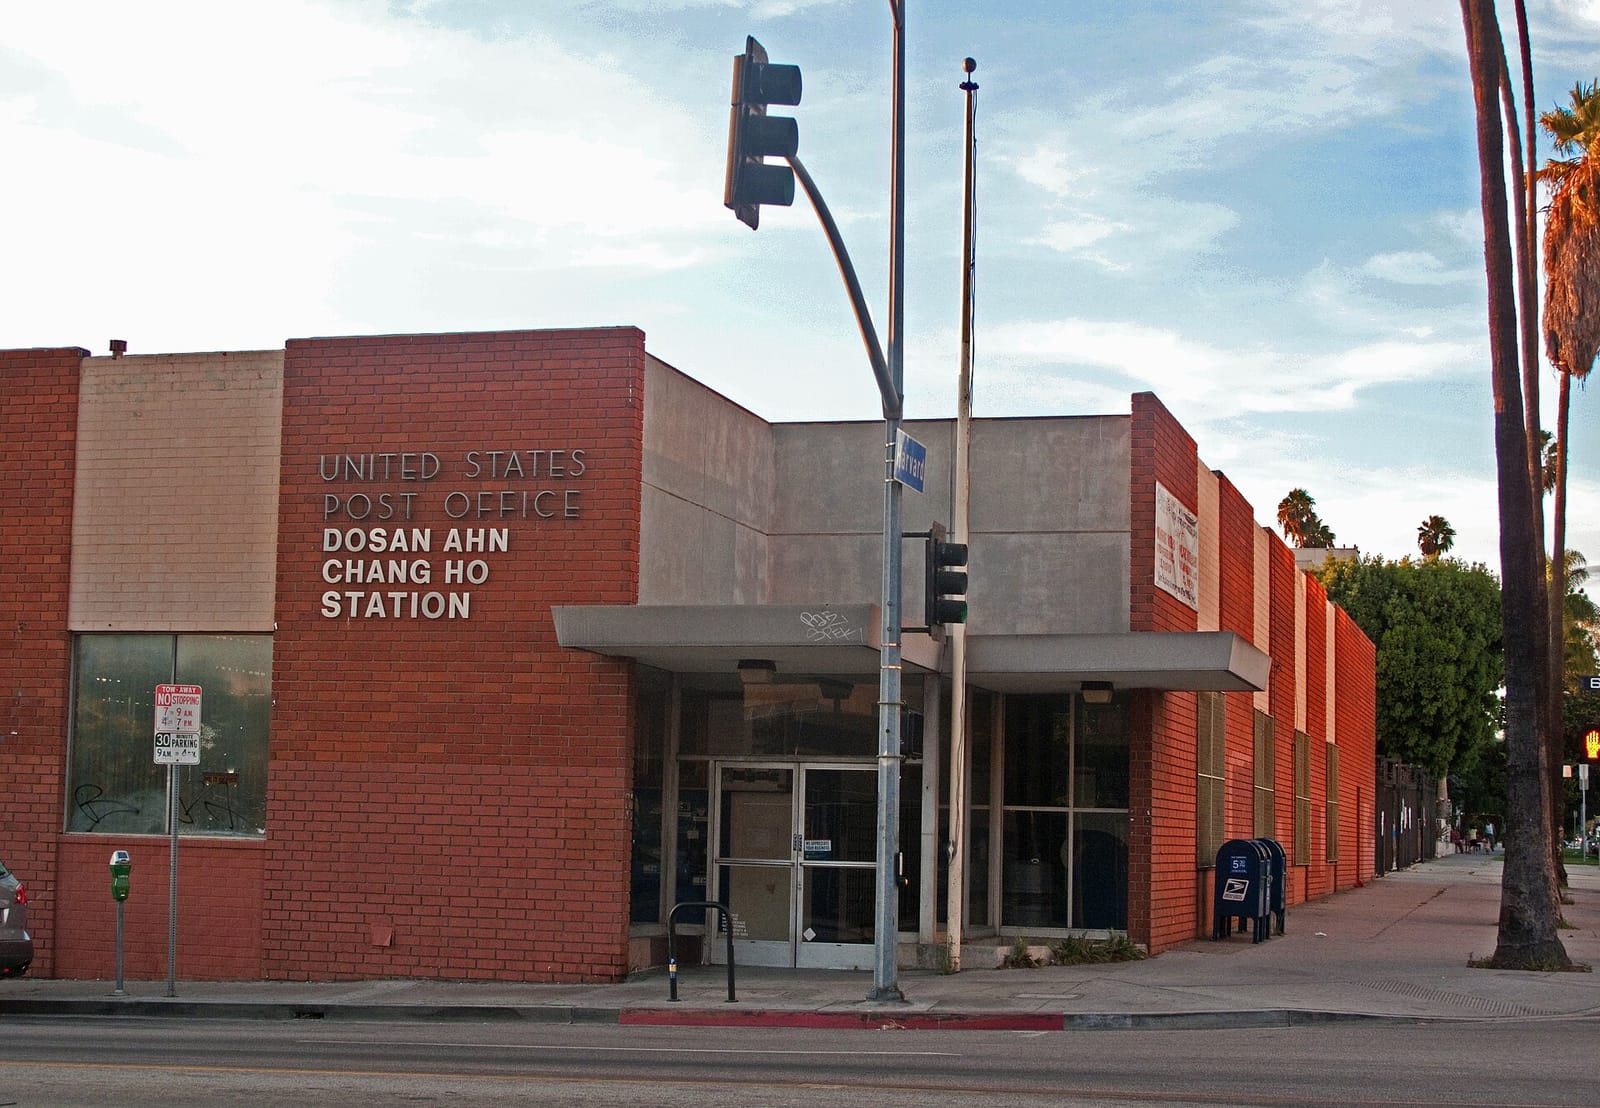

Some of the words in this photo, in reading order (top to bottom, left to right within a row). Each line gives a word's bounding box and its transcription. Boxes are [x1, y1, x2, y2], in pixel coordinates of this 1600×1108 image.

[320, 453, 440, 481] UNITED
[465, 450, 586, 478] STATES
[324, 492, 418, 520] POST
[444, 490, 581, 518] OFFICE
[323, 528, 431, 552] DOSAN
[443, 528, 509, 552] AHN
[322, 559, 431, 584] CHANG
[445, 559, 489, 584] HO
[321, 591, 470, 618] STATION
[158, 693, 171, 705] NO
[172, 695, 199, 705] STOPPING
[164, 707, 169, 716] 7
[176, 707, 181, 717] 9
[156, 734, 170, 746] 30
[172, 739, 198, 748] PARKING
[1232, 860, 1239, 869] 5
